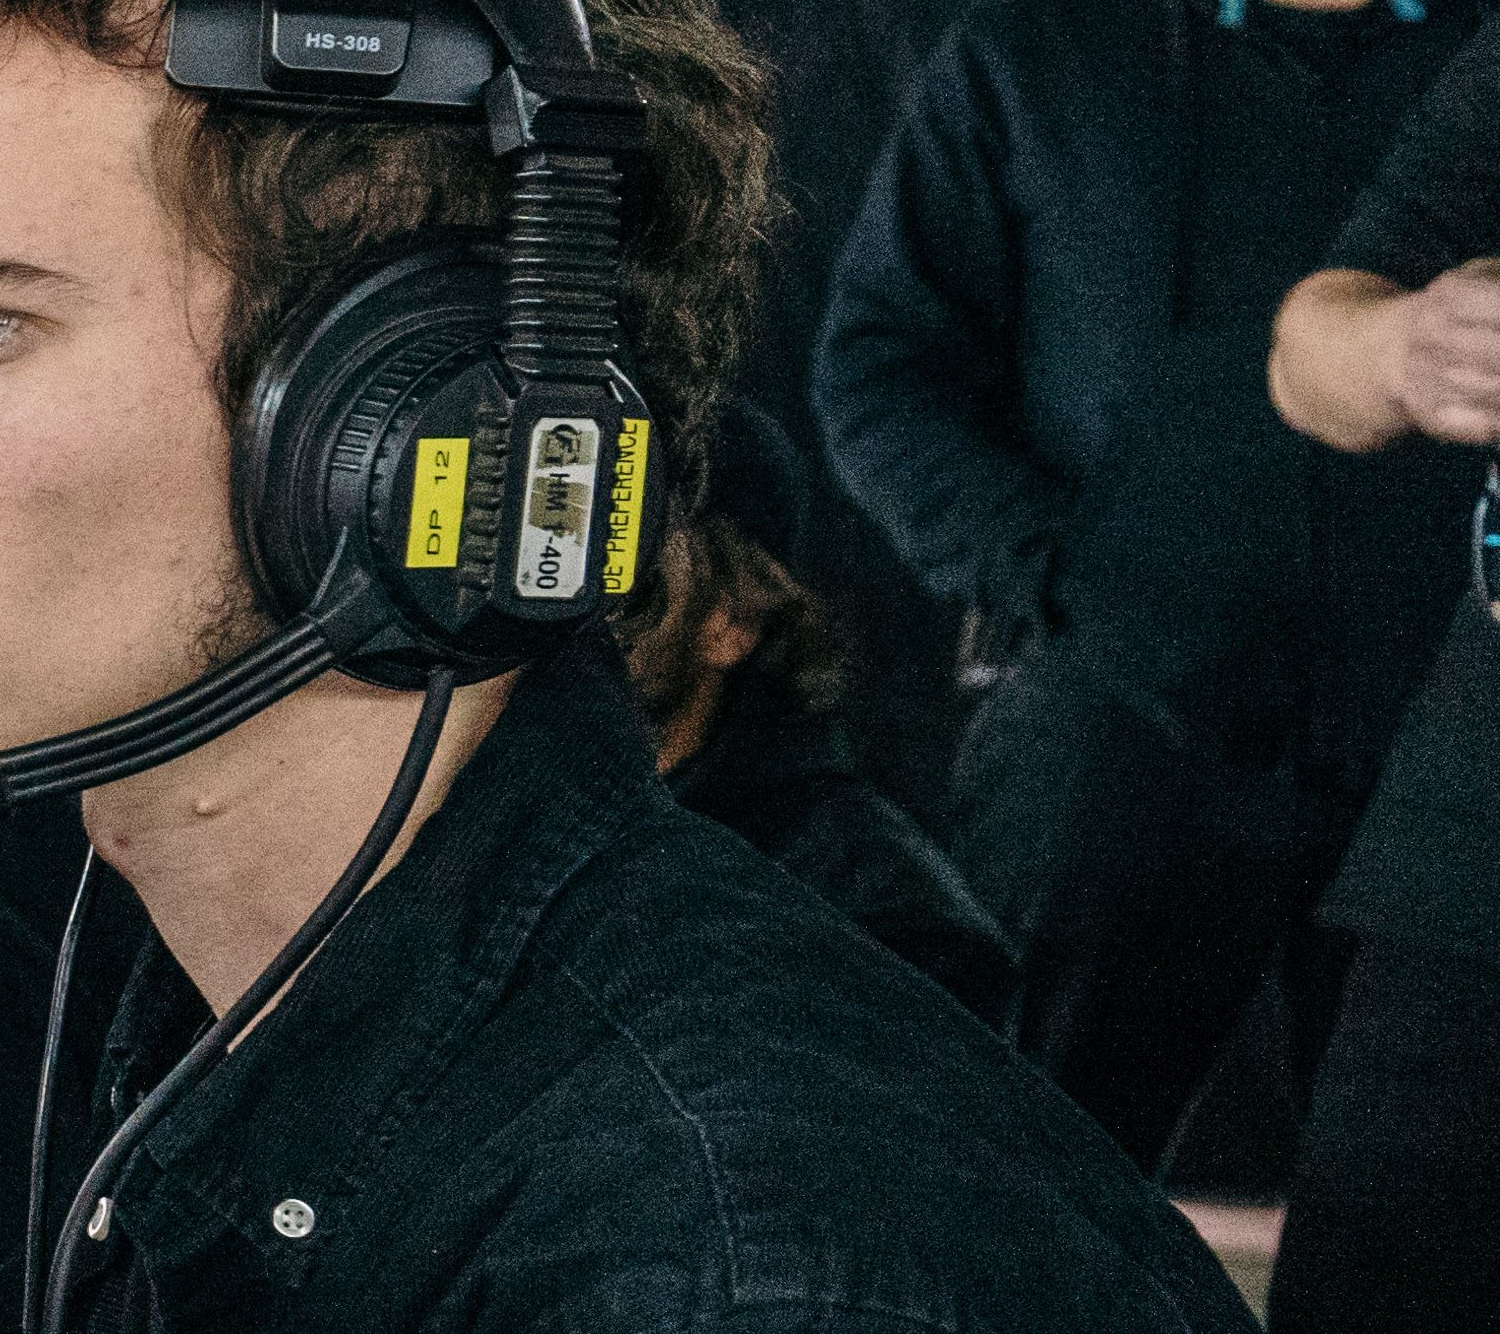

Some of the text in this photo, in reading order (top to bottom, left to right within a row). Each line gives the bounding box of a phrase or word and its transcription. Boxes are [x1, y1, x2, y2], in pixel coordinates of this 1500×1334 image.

[305, 32, 381, 53] HS-308
[426, 449, 451, 555] DP 12
